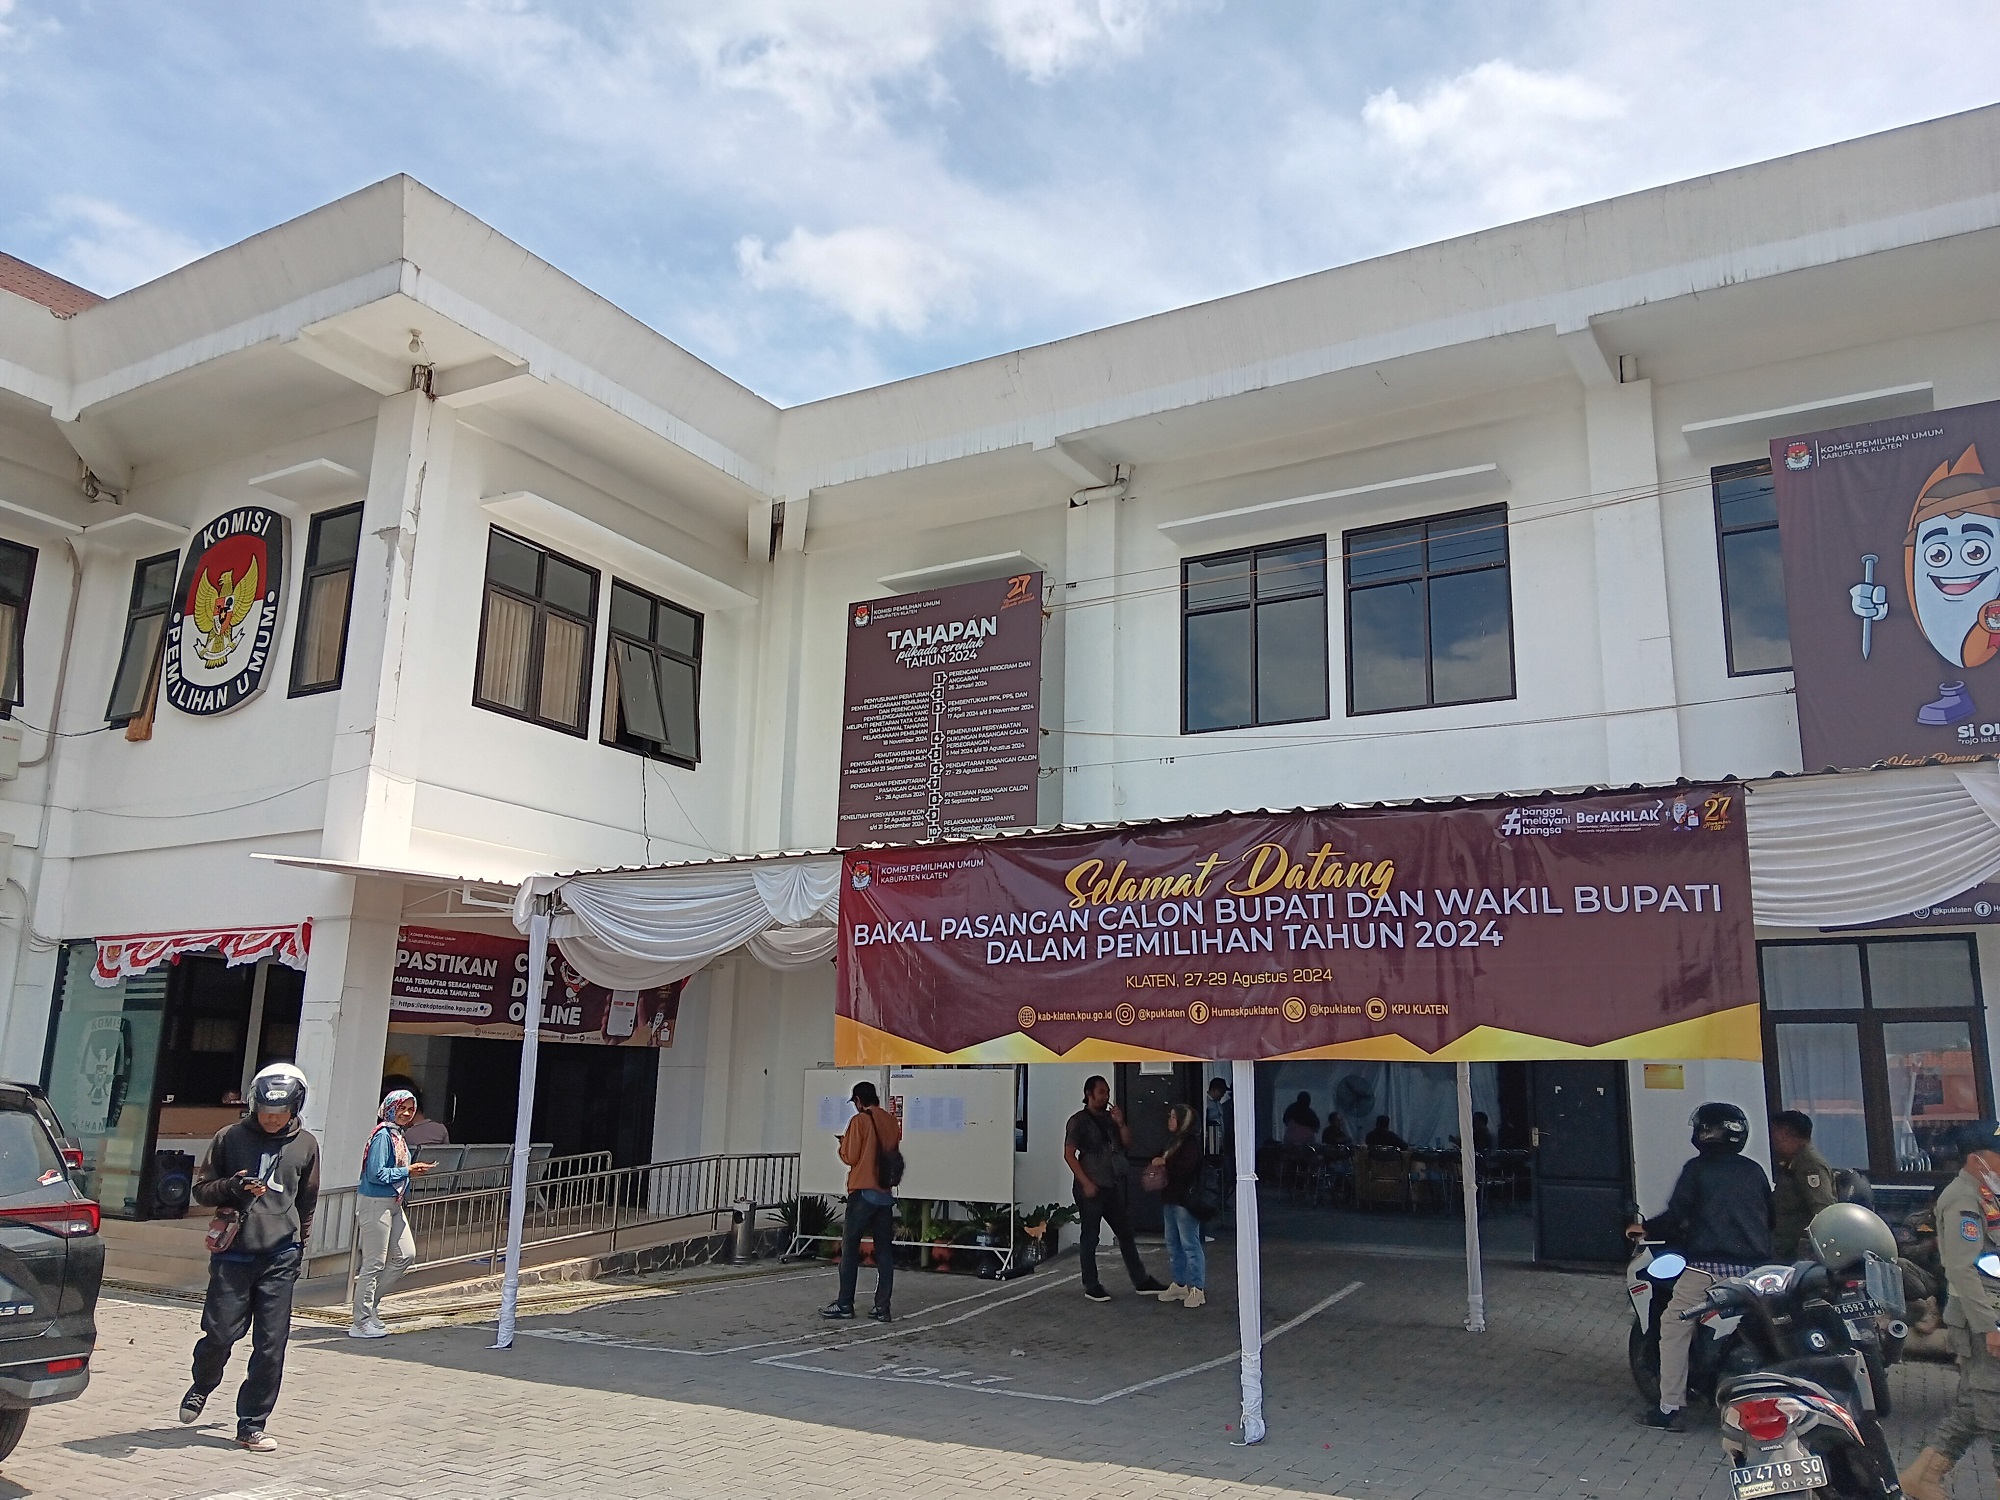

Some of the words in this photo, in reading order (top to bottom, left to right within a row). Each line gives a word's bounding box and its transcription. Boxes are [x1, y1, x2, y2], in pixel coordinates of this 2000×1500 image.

[1820, 442, 1854, 454] KOMISI
[1856, 434, 1909, 448] PEMILIHAN
[1912, 429, 1945, 440] UMUM
[1821, 448, 1870, 460] KABUPATEN
[1871, 443, 1903, 452] KLATEN
[203, 511, 272, 549] KOMISI
[1007, 574, 1032, 598] 27
[893, 603, 922, 612] PEMILIHAN
[888, 616, 997, 650] TAHAPAN
[166, 627, 228, 711] PEMILIHAN
[237, 606, 276, 695] UMUM
[896, 641, 938, 664] pilkada
[941, 636, 984, 653] serentak
[905, 653, 946, 668] TAHUN
[949, 649, 978, 662] 2024
[1958, 724, 1975, 738] Si
[1522, 808, 1563, 817] bangga
[1576, 809, 1659, 823] BerAKHLAK
[1704, 797, 1732, 821] 27
[1522, 816, 1571, 826] melayani
[1522, 826, 1562, 836] bangsa
[881, 866, 909, 875] KOMISI
[911, 862, 955, 872] PEMILIHAN
[957, 860, 984, 869] UMUM
[1064, 852, 1229, 910] Selamat
[1226, 842, 1395, 898] Datang
[881, 875, 920, 883] KABUPATEN
[854, 918, 933, 946] BAKAL
[940, 909, 1090, 940] PASANGAN
[1097, 900, 1202, 931] CALON
[1215, 892, 1334, 926] BUPATI
[1348, 889, 1424, 919] DAN
[1436, 886, 1564, 917] WAKIL
[1574, 884, 1722, 914] BUPATI
[1932, 906, 1972, 916] @kpuklaten
[987, 937, 1085, 965] DALAM
[1097, 927, 1273, 959] PEMILIHAN
[1282, 923, 1404, 950] TAHUN
[1416, 920, 1503, 948] 2024
[395, 950, 498, 977] PASTIKAN
[515, 953, 556, 975] CK
[414, 978, 446, 987] TERDAFTAR
[1126, 974, 1180, 988] KLATEN,
[1184, 972, 1228, 986] 27-29
[1232, 969, 1288, 987] Agustus
[1292, 969, 1333, 983] 2024
[511, 978, 553, 999] DT
[509, 1002, 582, 1025] OLINE
[1037, 1008, 1113, 1022] kab-klaten.kpu.go.id
[1138, 1007, 1186, 1020] @kpuklaten
[1211, 1005, 1279, 1019] Humaskpuklaten
[1309, 1004, 1362, 1016] @kpuklaten
[1391, 1004, 1411, 1016] KPU
[1413, 1003, 1449, 1015] KLATEN
[1842, 1303, 1864, 1313] 6593
[1733, 1471, 1751, 1485] AD
[1757, 1464, 1792, 1480] 4718
